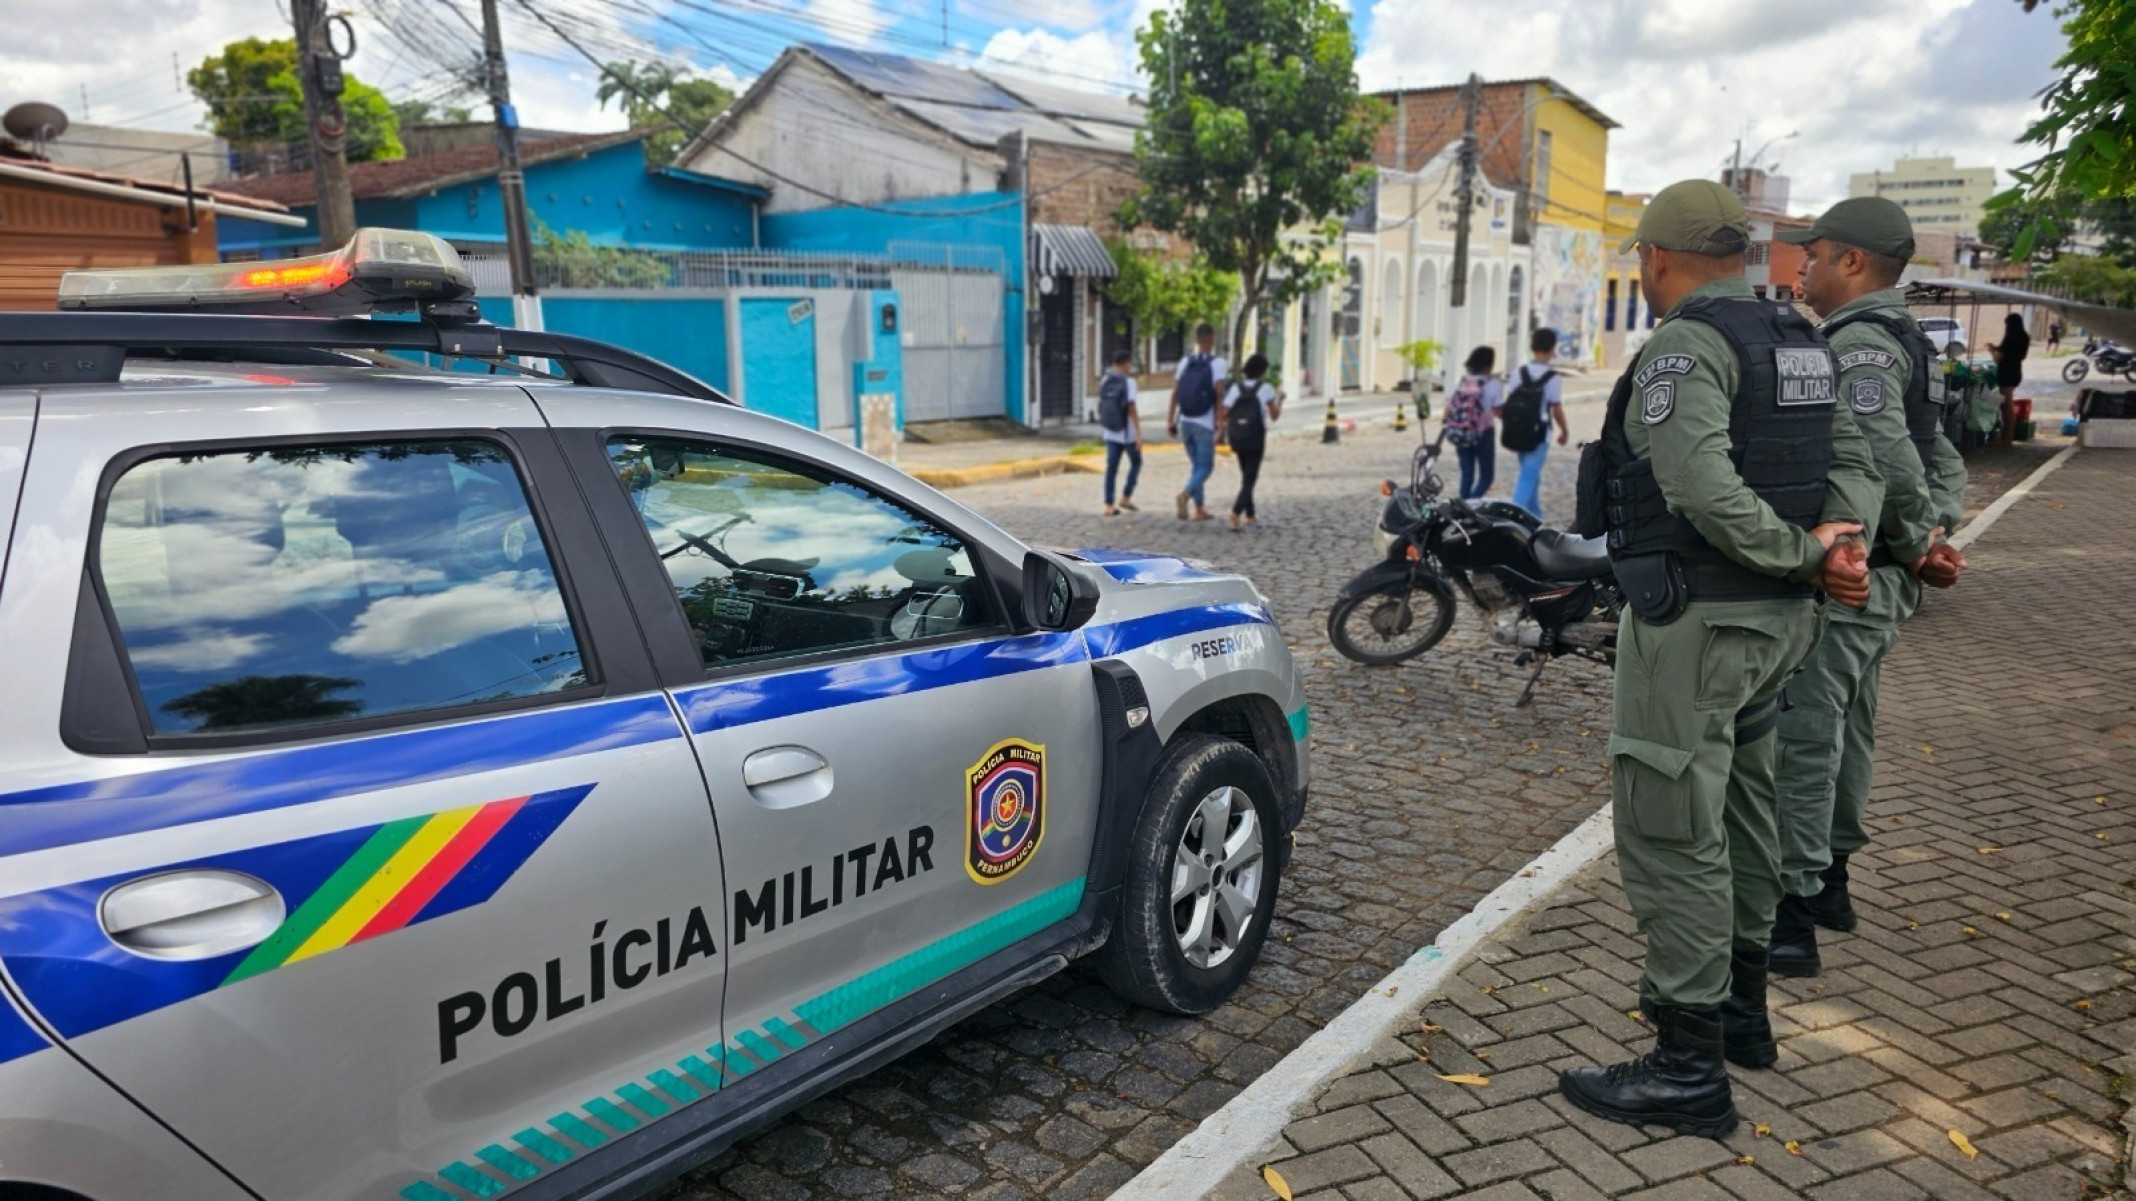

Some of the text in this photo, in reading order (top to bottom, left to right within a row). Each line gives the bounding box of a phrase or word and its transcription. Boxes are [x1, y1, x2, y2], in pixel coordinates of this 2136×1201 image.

[1656, 357, 1690, 370] BPM
[1857, 352, 1887, 364] BPM
[1783, 379, 1830, 400] MILITAR
[1191, 633, 1253, 661] RESERVA
[1010, 748, 1041, 763] MILITAR
[977, 840, 1033, 875] PERNAMBUCO
[438, 824, 935, 1065] POLÍCIA MILITAR
